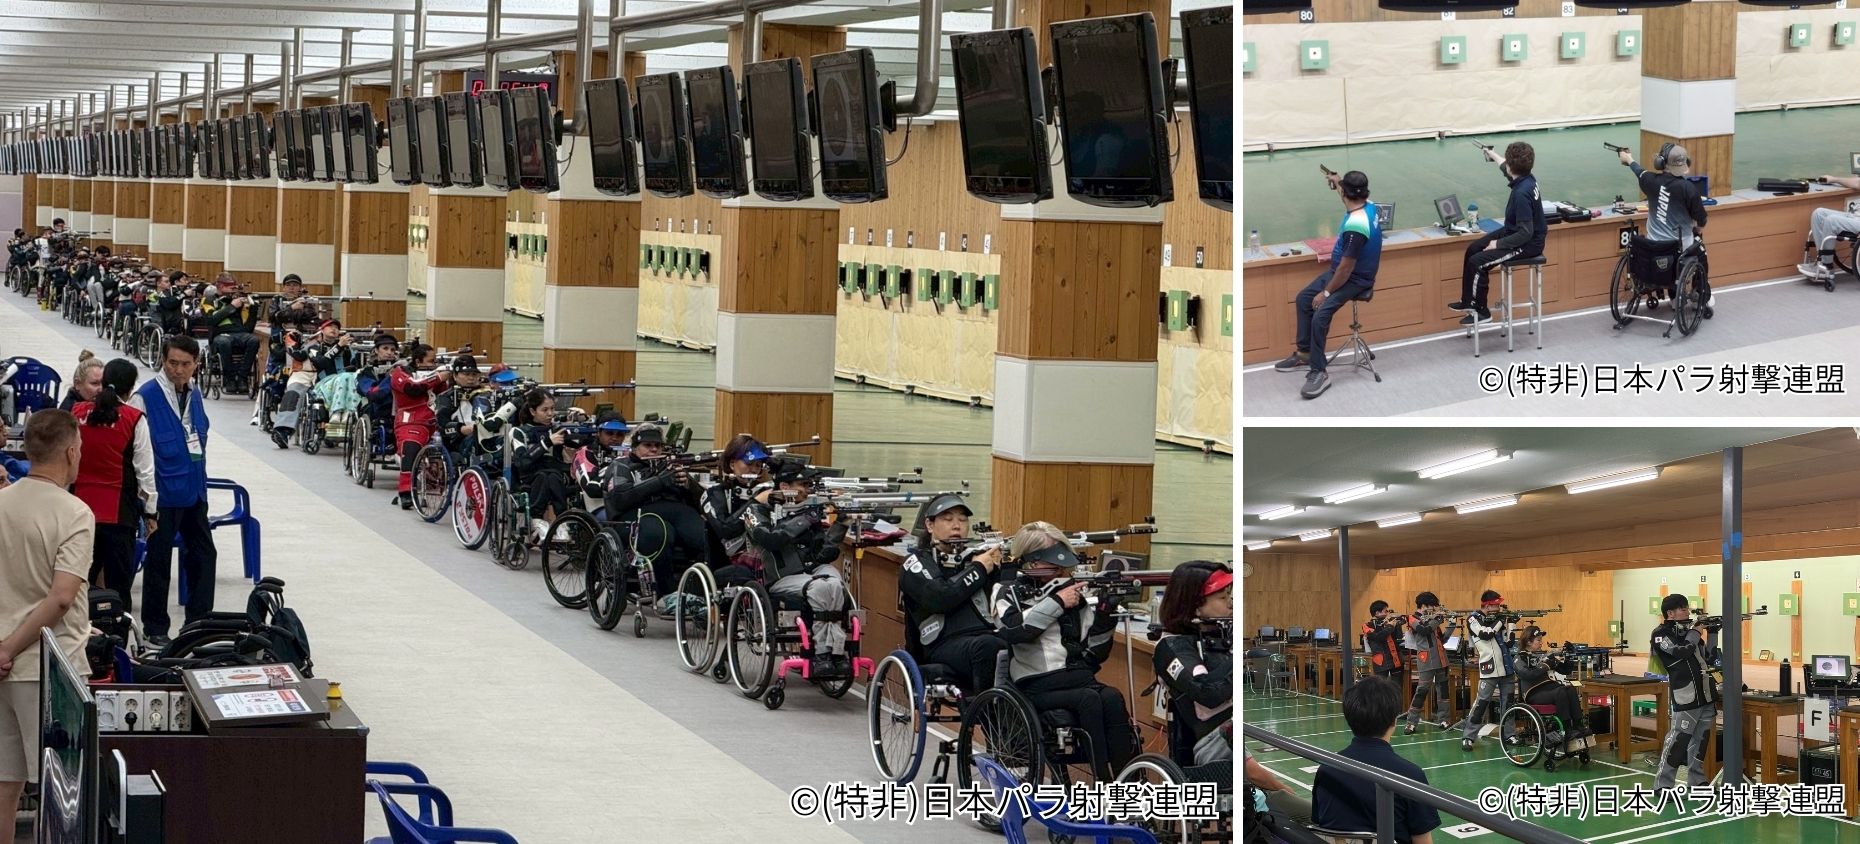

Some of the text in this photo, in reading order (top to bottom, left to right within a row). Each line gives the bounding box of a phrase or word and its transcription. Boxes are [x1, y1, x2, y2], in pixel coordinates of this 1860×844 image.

[1300, 11, 1313, 21] 80
[1503, 6, 1514, 16] 82
[1563, 5, 1573, 14] 83
[1656, 185, 1671, 225] JAPAN
[1196, 251, 1204, 264] 50
[963, 570, 980, 587] LYJ
[1811, 709, 1823, 727] F
